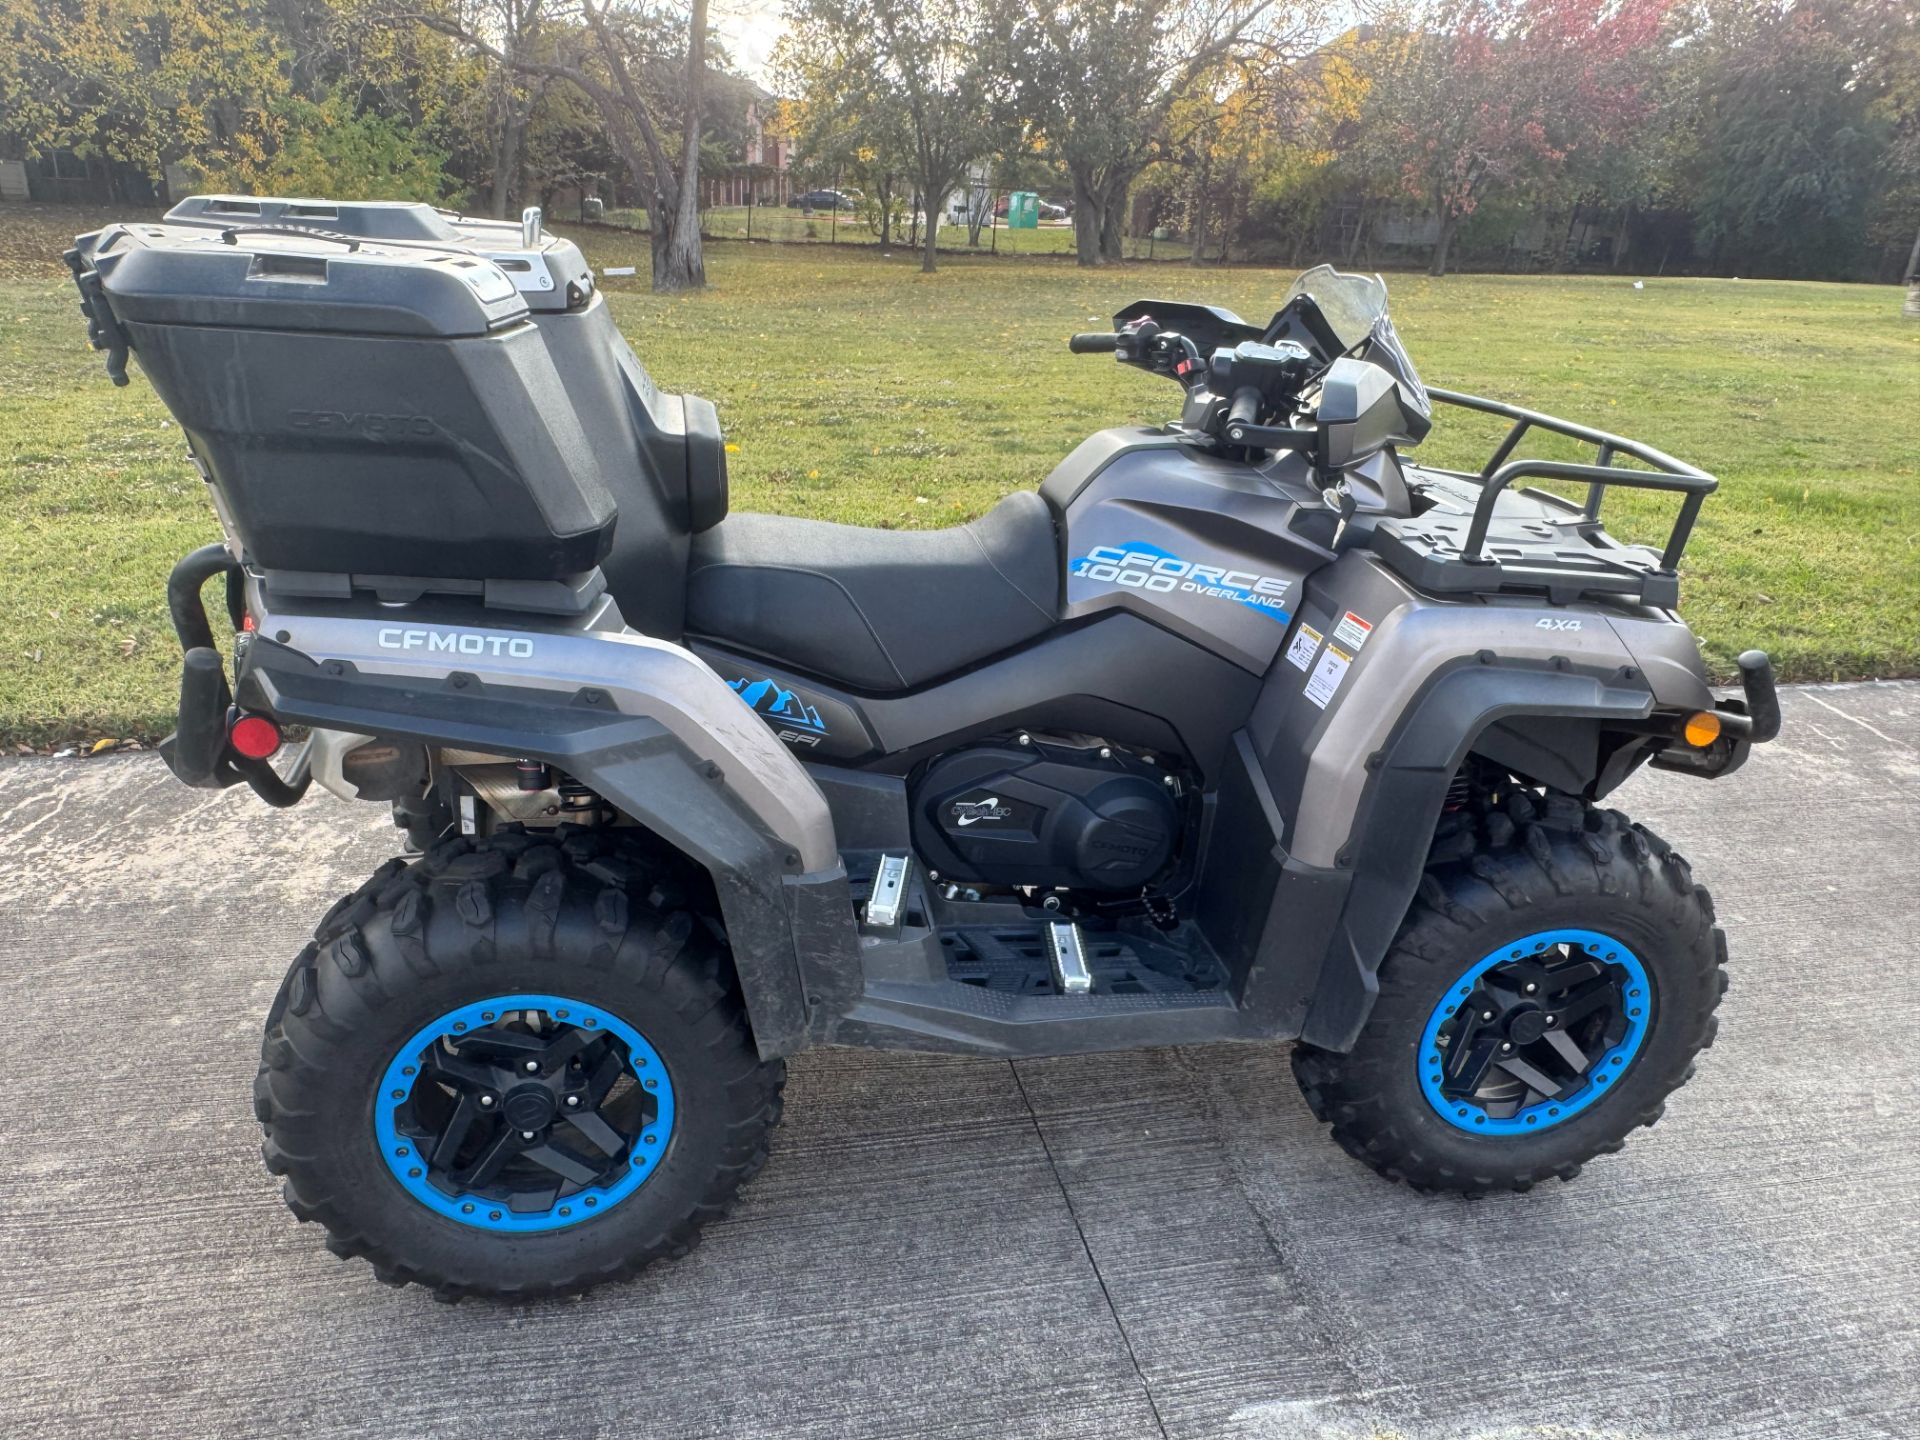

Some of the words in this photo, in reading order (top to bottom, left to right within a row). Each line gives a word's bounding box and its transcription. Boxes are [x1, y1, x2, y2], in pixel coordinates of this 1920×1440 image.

[288, 408, 436, 436] CFMOTO
[1073, 562, 1178, 593] 1000
[1180, 581, 1286, 609] OVERLAND
[1086, 545, 1293, 597] CFORCE
[378, 628, 534, 658] CFMOTO
[778, 730, 821, 747] EFI
